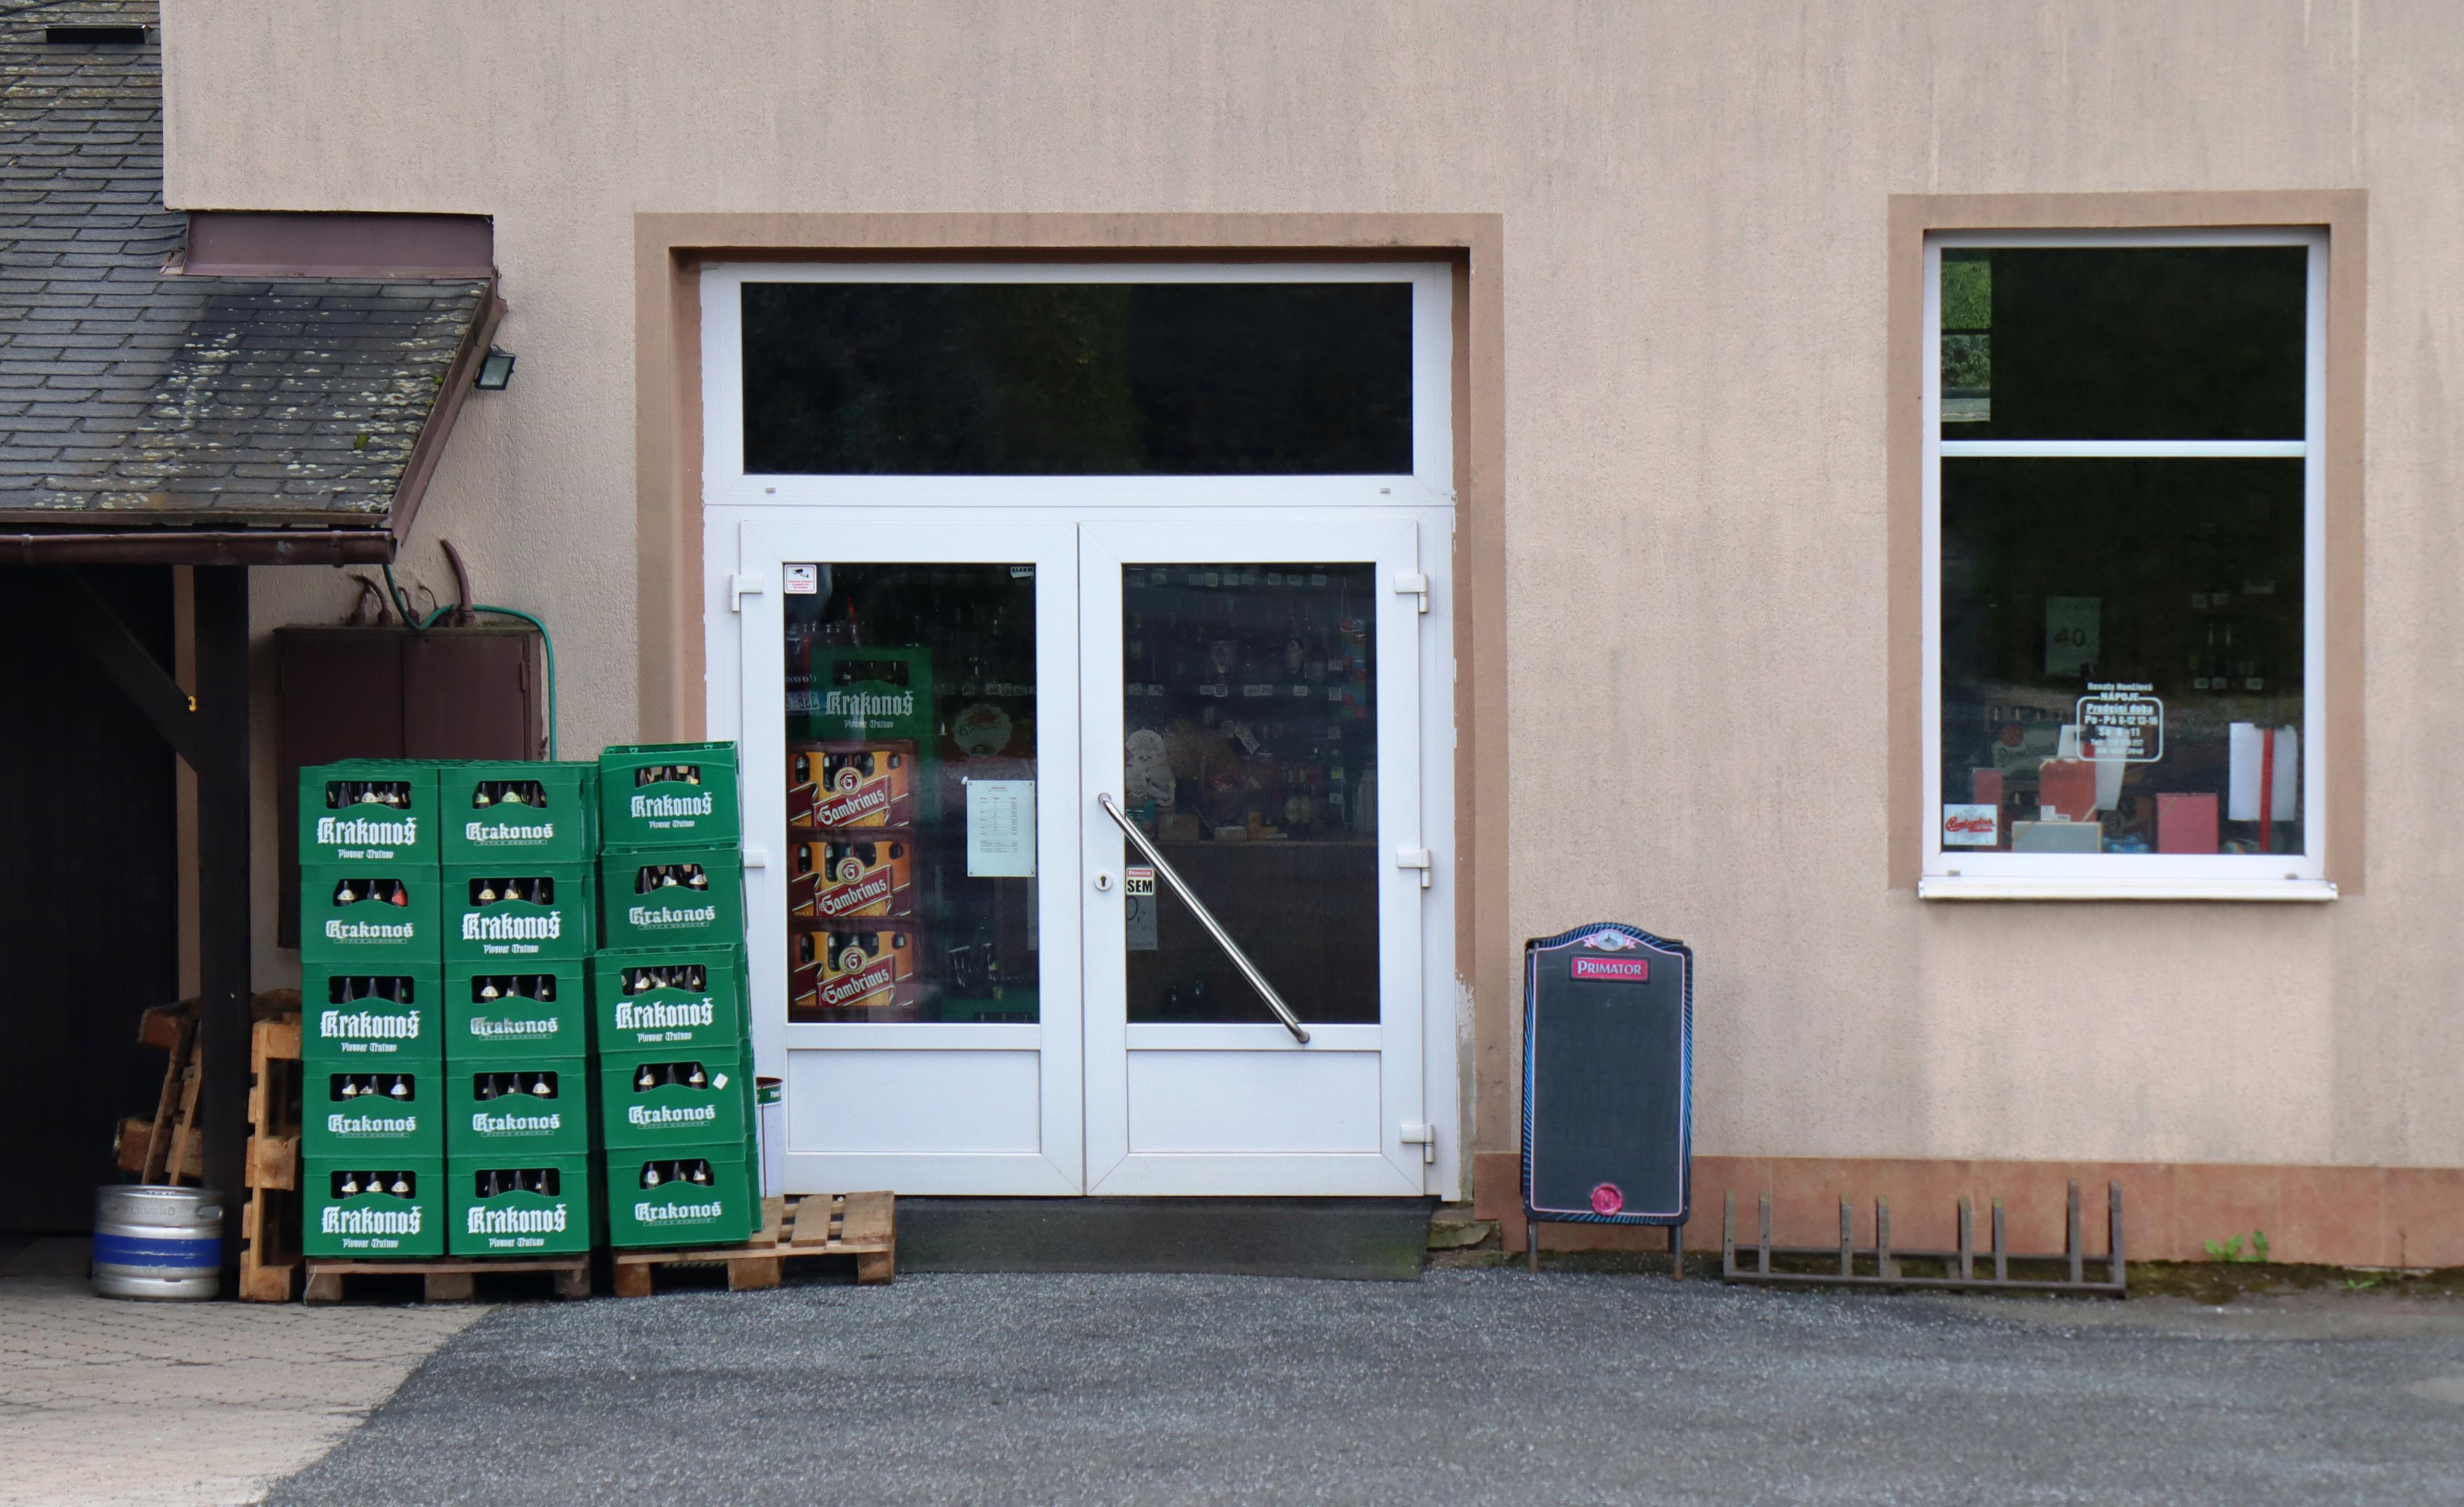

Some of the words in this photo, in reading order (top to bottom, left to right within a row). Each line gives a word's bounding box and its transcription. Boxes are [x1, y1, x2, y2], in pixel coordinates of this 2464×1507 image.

[825, 691, 914, 717] Krakonoš
[2100, 691, 2139, 701] NÁPOJE
[2086, 703, 2128, 713] Prodejní
[2129, 704, 2154, 713] doba
[2085, 715, 2097, 725] Po
[2103, 715, 2117, 725] Pá
[2131, 728, 2141, 736] 11
[631, 792, 712, 818] Krakonoš
[817, 789, 885, 825] Gambrinus
[317, 817, 416, 845] Krakonoš
[466, 822, 554, 842] Krakonoš
[338, 849, 362, 858] Pivovar
[1127, 879, 1153, 893] SEM
[819, 879, 886, 915] Gambrinus
[462, 911, 561, 940] Krakonoš
[630, 906, 715, 927] Krakonoš
[326, 920, 413, 940] Krakonoš
[483, 944, 509, 954] Pivovar
[1577, 960, 1642, 975] PRIMATOR
[822, 968, 889, 1004] Gambrinus
[615, 997, 713, 1029] Krakonoš
[320, 1010, 420, 1039] Krakonoš
[471, 1017, 558, 1036] Krakonoš
[341, 1042, 367, 1052] Pivovar
[637, 1033, 663, 1042] Pivovar
[328, 1114, 416, 1134] Krakonoš
[472, 1113, 560, 1132] Krakonoš
[629, 1105, 715, 1125] Krakonoš
[322, 1206, 422, 1235] Krakonoš
[468, 1204, 567, 1233] Krakonoš
[635, 1202, 721, 1222] Krakonoš
[342, 1238, 369, 1248] Pivovar
[488, 1238, 514, 1248] Pivovar
